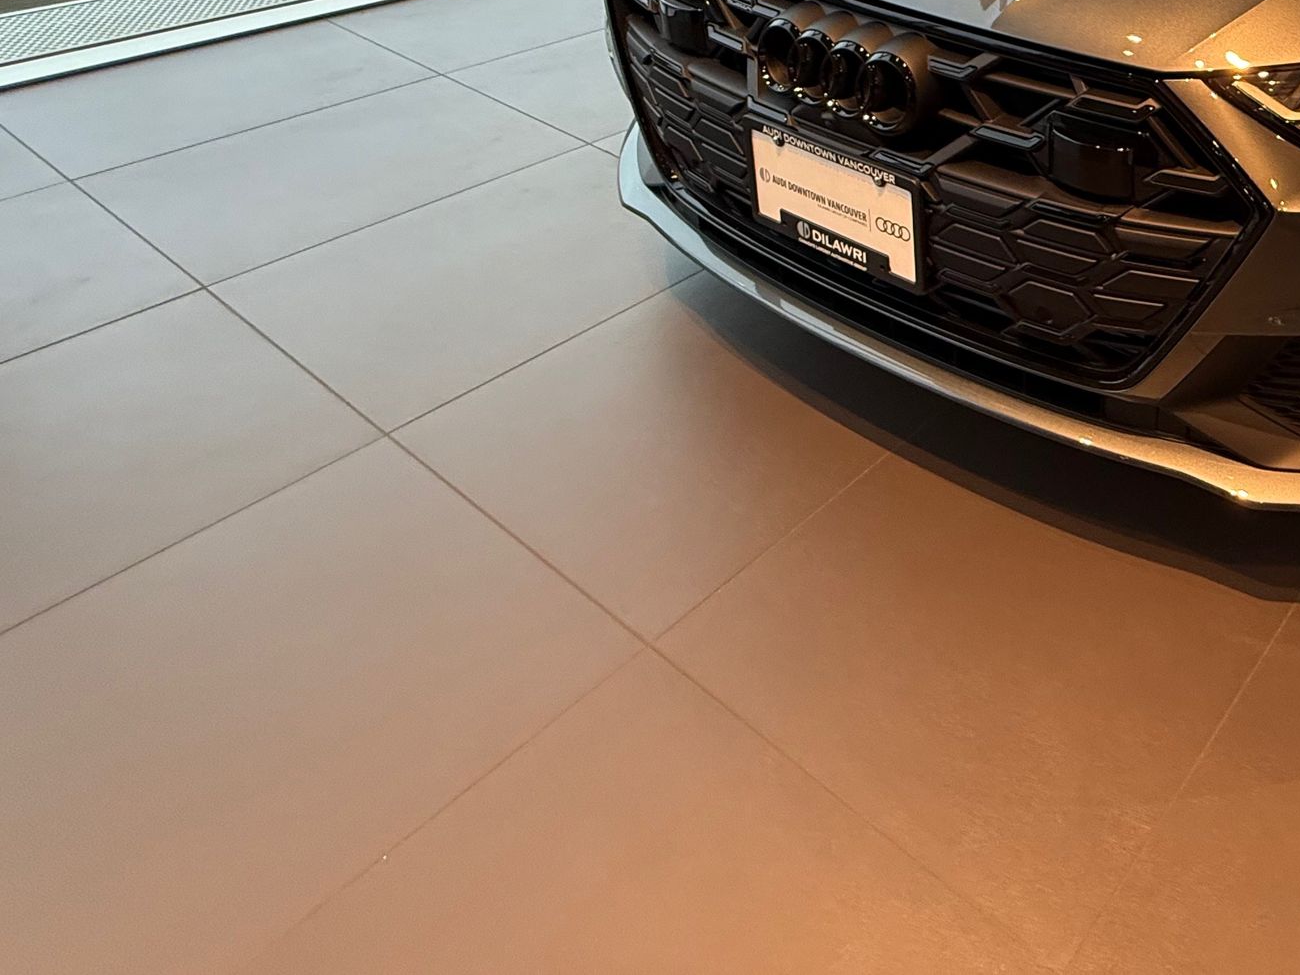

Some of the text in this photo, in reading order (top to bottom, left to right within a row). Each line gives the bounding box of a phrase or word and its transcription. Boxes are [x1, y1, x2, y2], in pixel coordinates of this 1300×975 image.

[762, 125, 896, 184] AUDI DOWNTOWN VANCOUVER
[772, 175, 787, 189] AUDI
[788, 181, 826, 205] DOWNTOWN
[826, 198, 868, 223] VANCOUVER
[811, 229, 867, 264] DILAWRI
